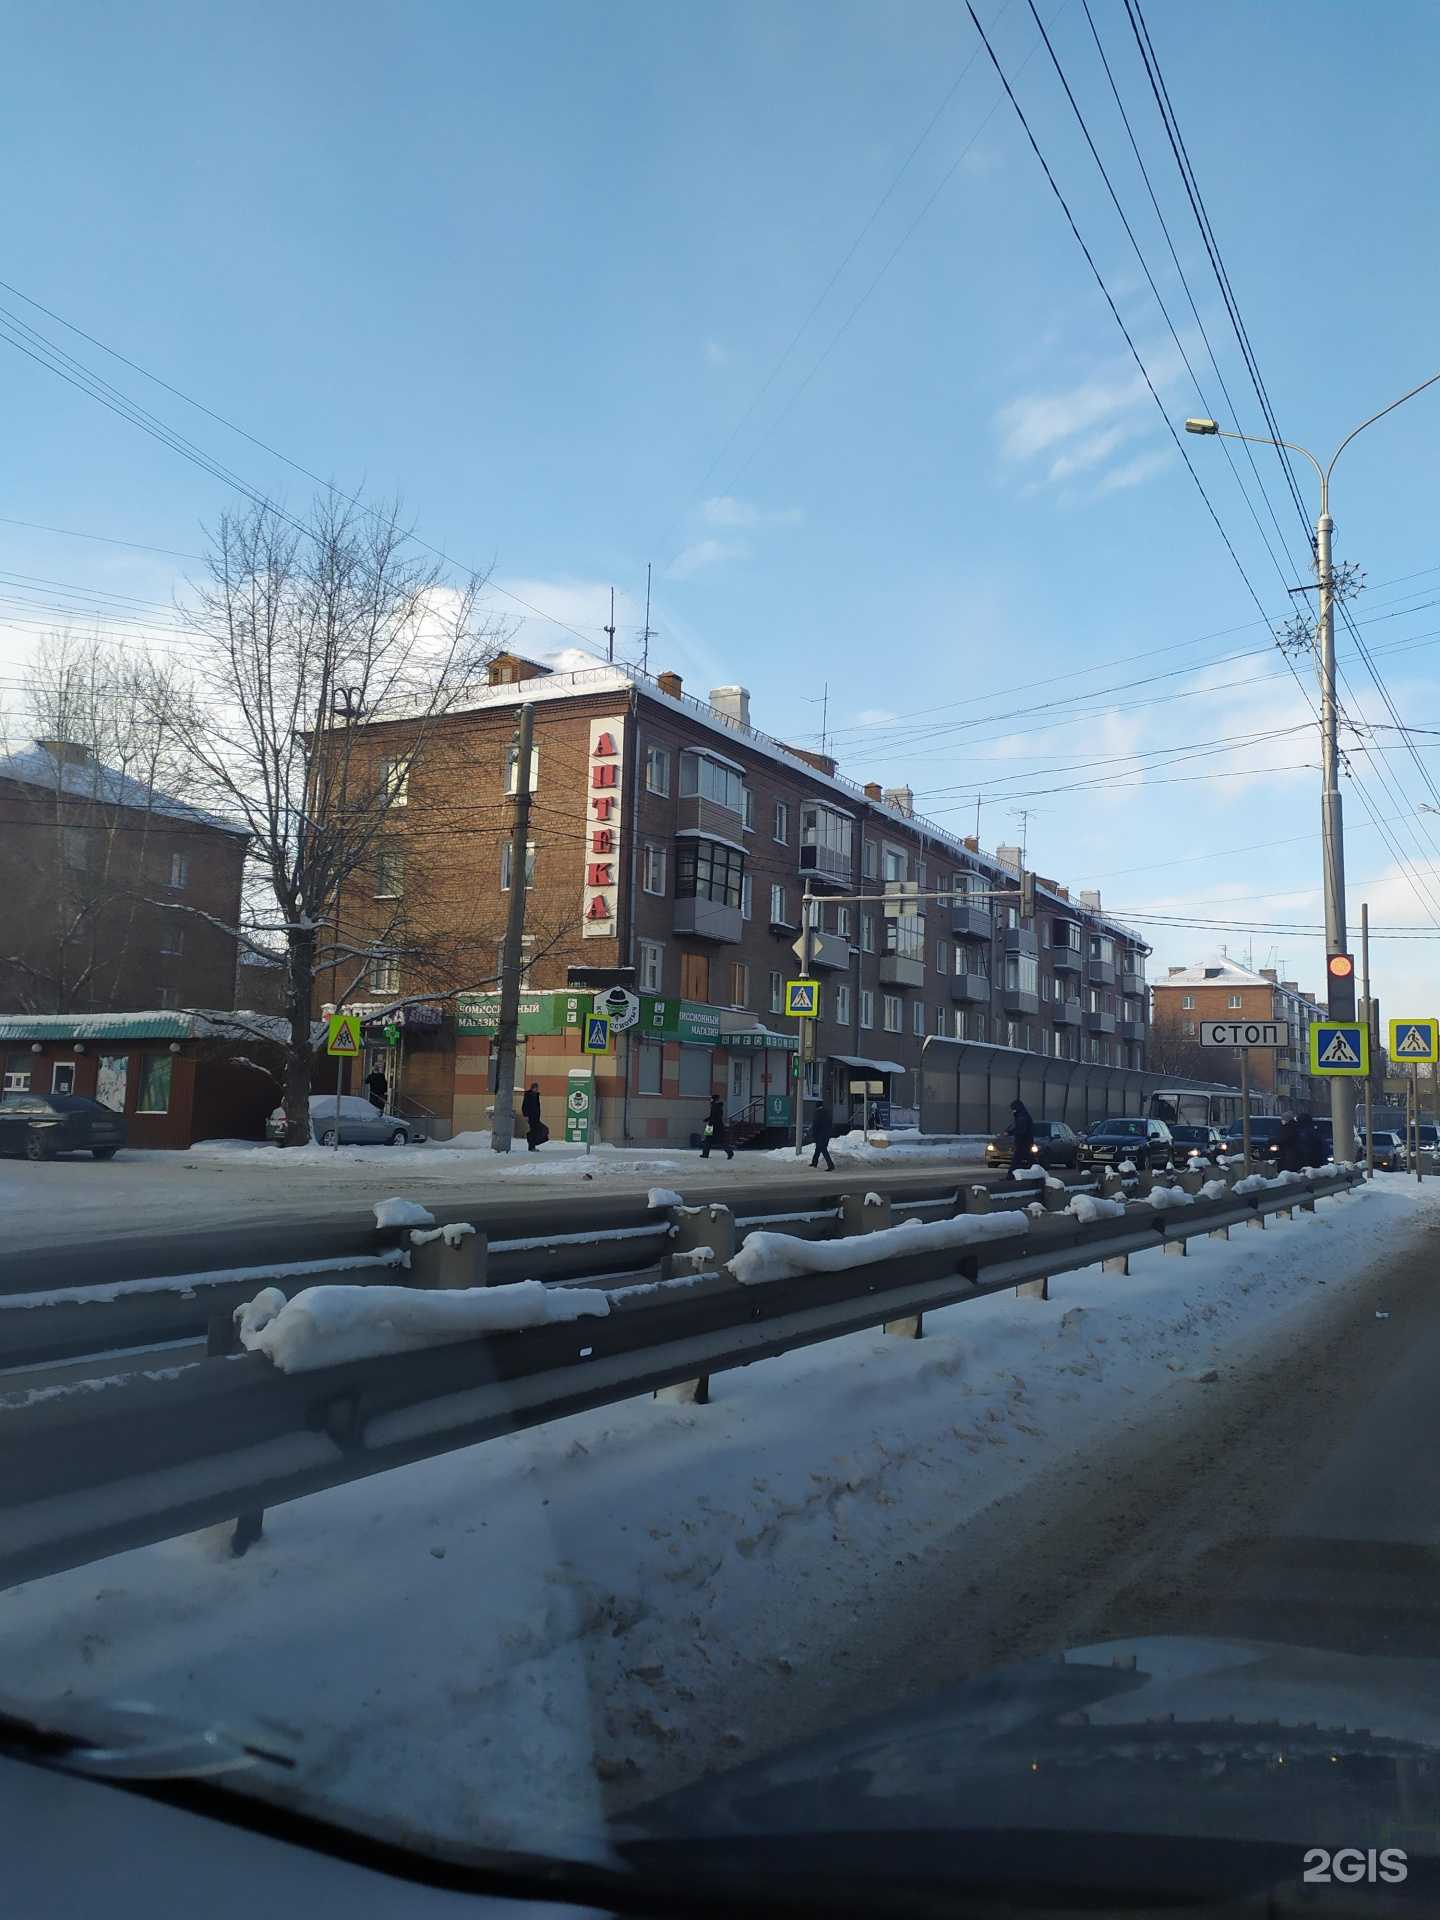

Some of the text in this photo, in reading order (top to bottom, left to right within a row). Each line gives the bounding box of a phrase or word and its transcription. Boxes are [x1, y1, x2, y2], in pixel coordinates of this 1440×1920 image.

[586, 732, 617, 919] АПТЕКА
[691, 1025, 719, 1037] МАГАЗИН
[1212, 1025, 1277, 1043] СТОП
